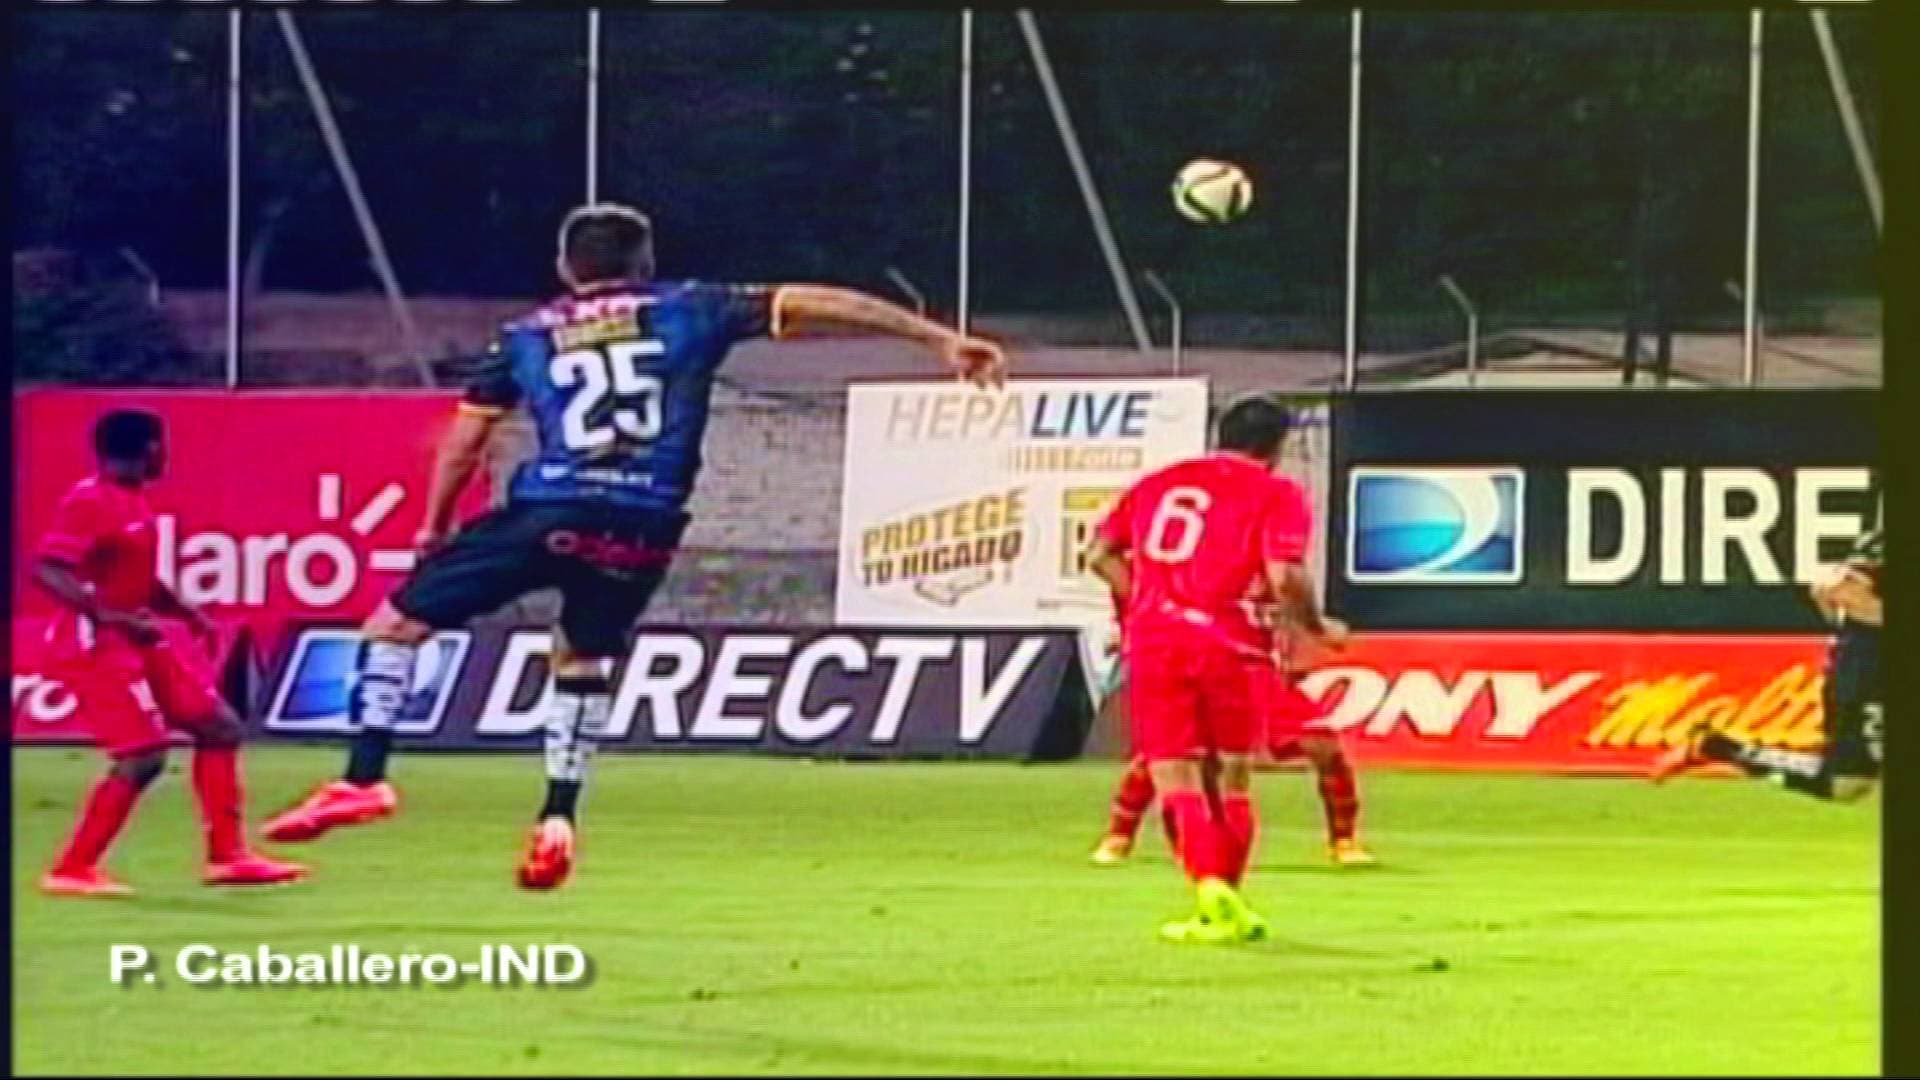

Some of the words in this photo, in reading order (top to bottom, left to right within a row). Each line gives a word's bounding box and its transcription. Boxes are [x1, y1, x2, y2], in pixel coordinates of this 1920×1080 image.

[549, 341, 666, 450] 25
[886, 391, 1154, 440] HEPALIVE
[862, 484, 1029, 555] PROTEGE
[1145, 486, 1212, 563] 6
[156, 514, 358, 607] laro
[475, 632, 1047, 741] DRECTV
[1298, 666, 1602, 738] ONY
